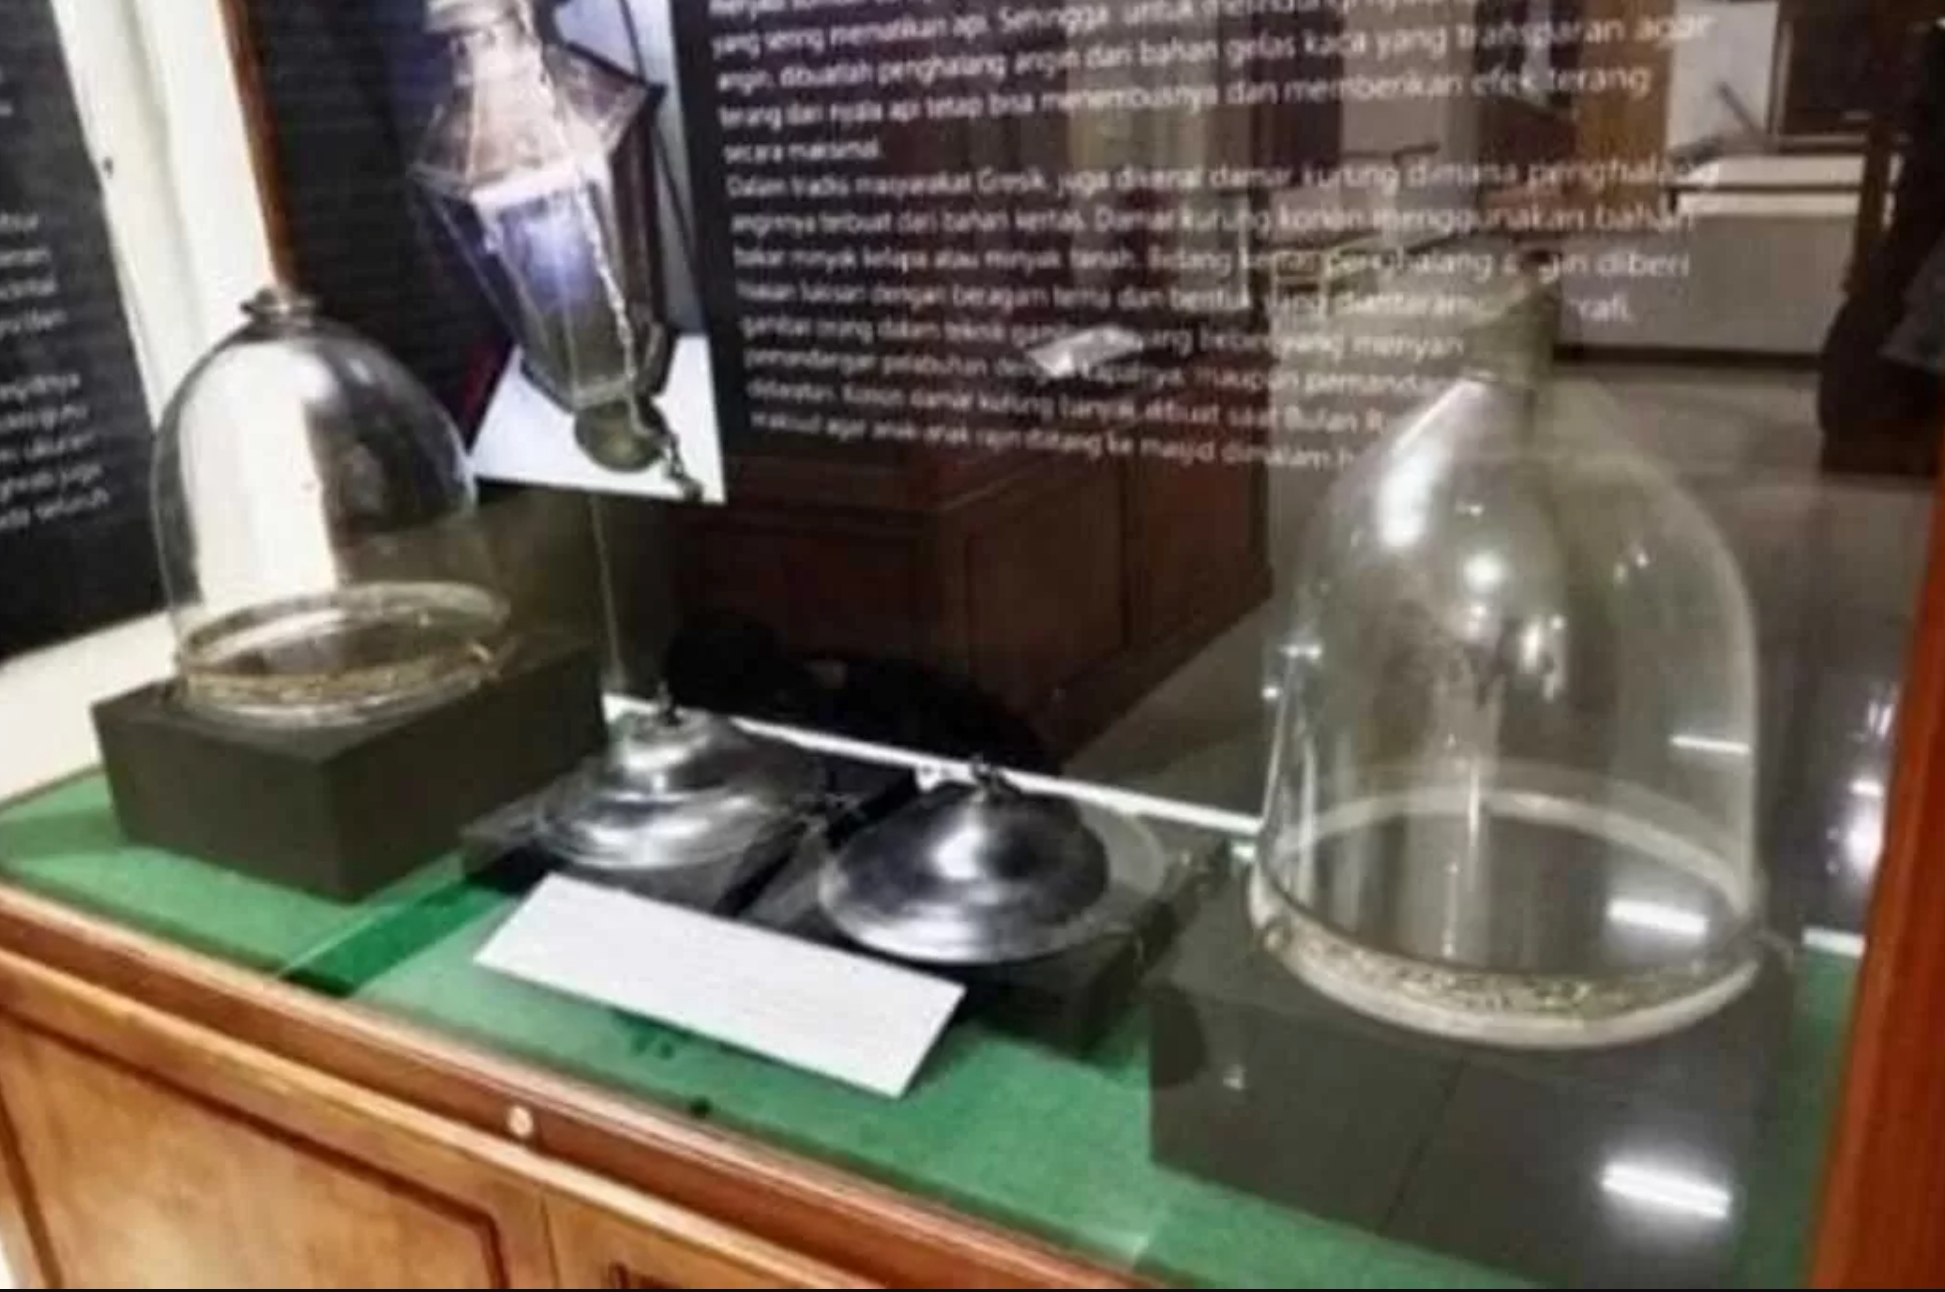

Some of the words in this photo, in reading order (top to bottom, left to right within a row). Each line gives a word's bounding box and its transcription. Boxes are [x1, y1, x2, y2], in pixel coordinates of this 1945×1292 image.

[712, 33, 760, 59] yang
[999, 6, 1109, 38] Sehingga
[877, 54, 1006, 86] penghalang
[1086, 43, 1132, 68] dari
[1141, 37, 1217, 67] bahan
[1375, 26, 1447, 60] yang
[1225, 78, 1278, 104] dan
